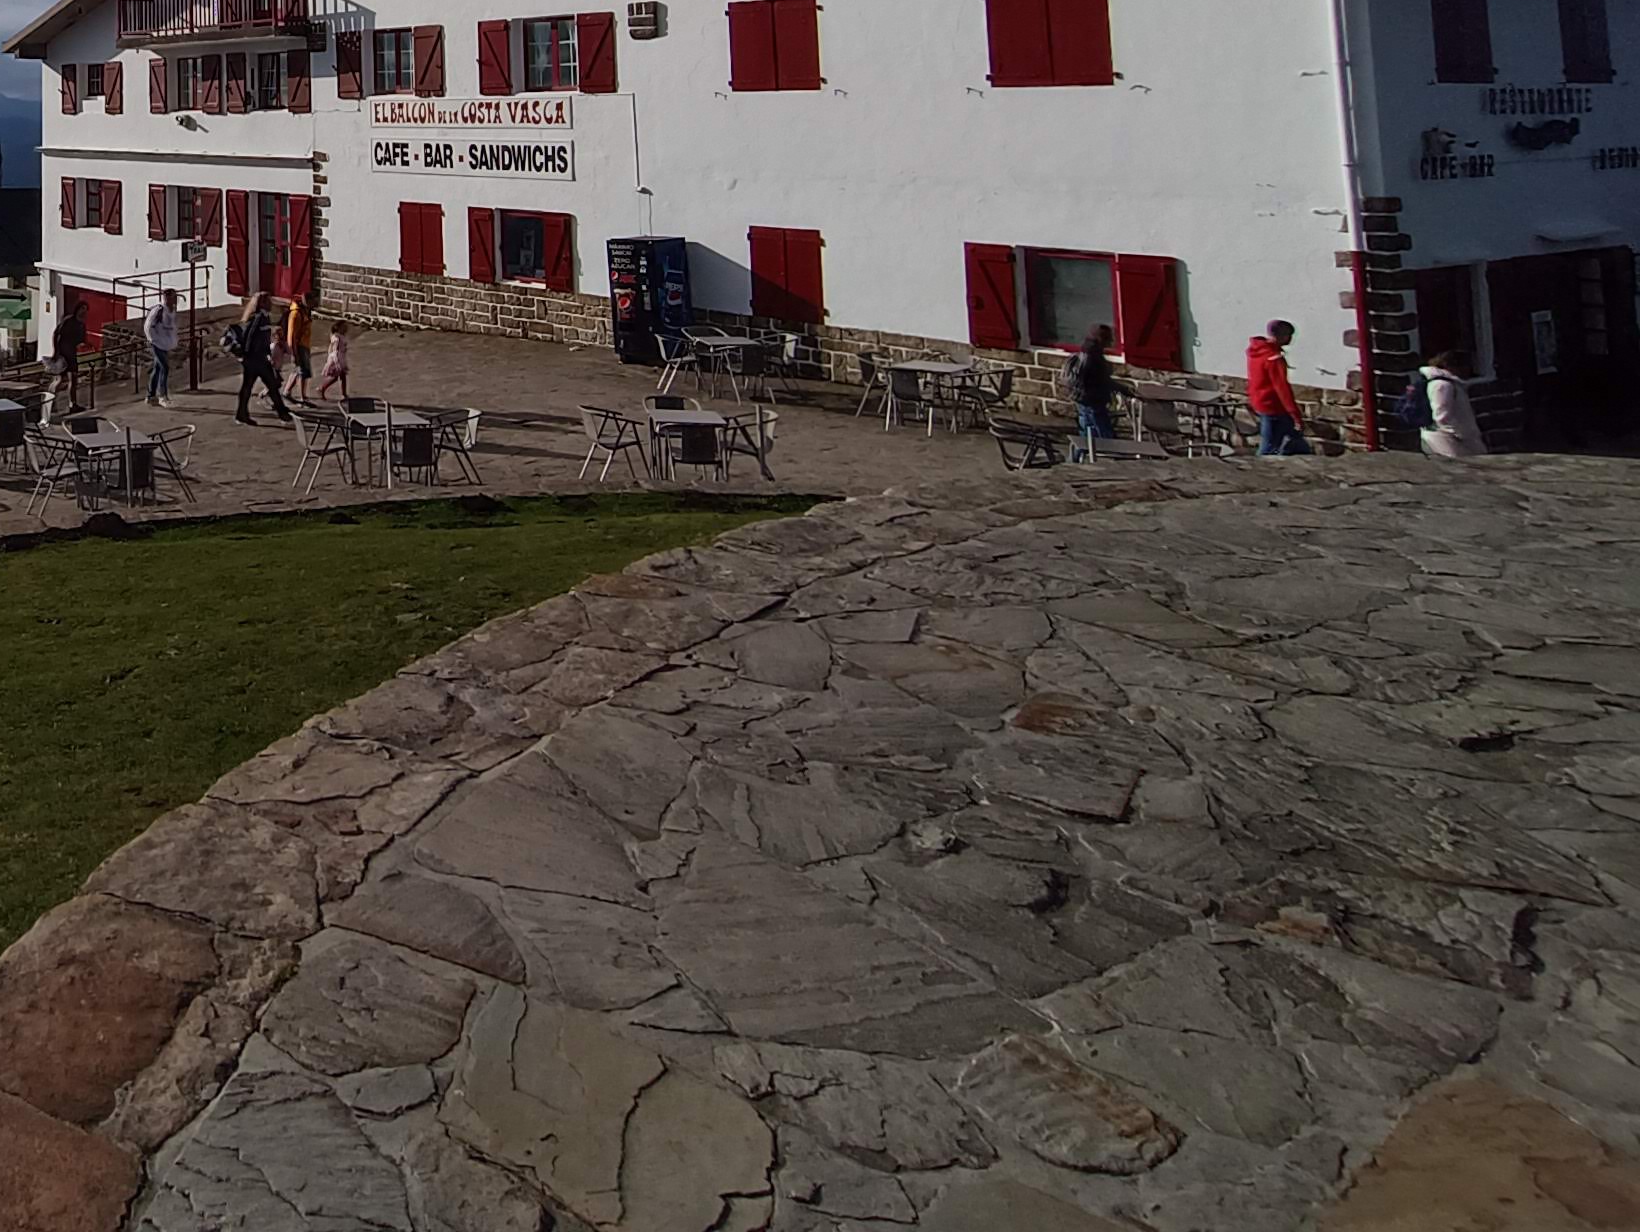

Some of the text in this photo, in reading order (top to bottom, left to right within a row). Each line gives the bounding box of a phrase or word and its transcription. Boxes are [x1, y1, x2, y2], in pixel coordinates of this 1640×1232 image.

[374, 103, 388, 123] EL
[390, 102, 435, 124] BALCON
[461, 100, 503, 124] COSTA
[506, 100, 566, 125] VASCA
[374, 141, 568, 173] CAFE BAR SANDWICHS
